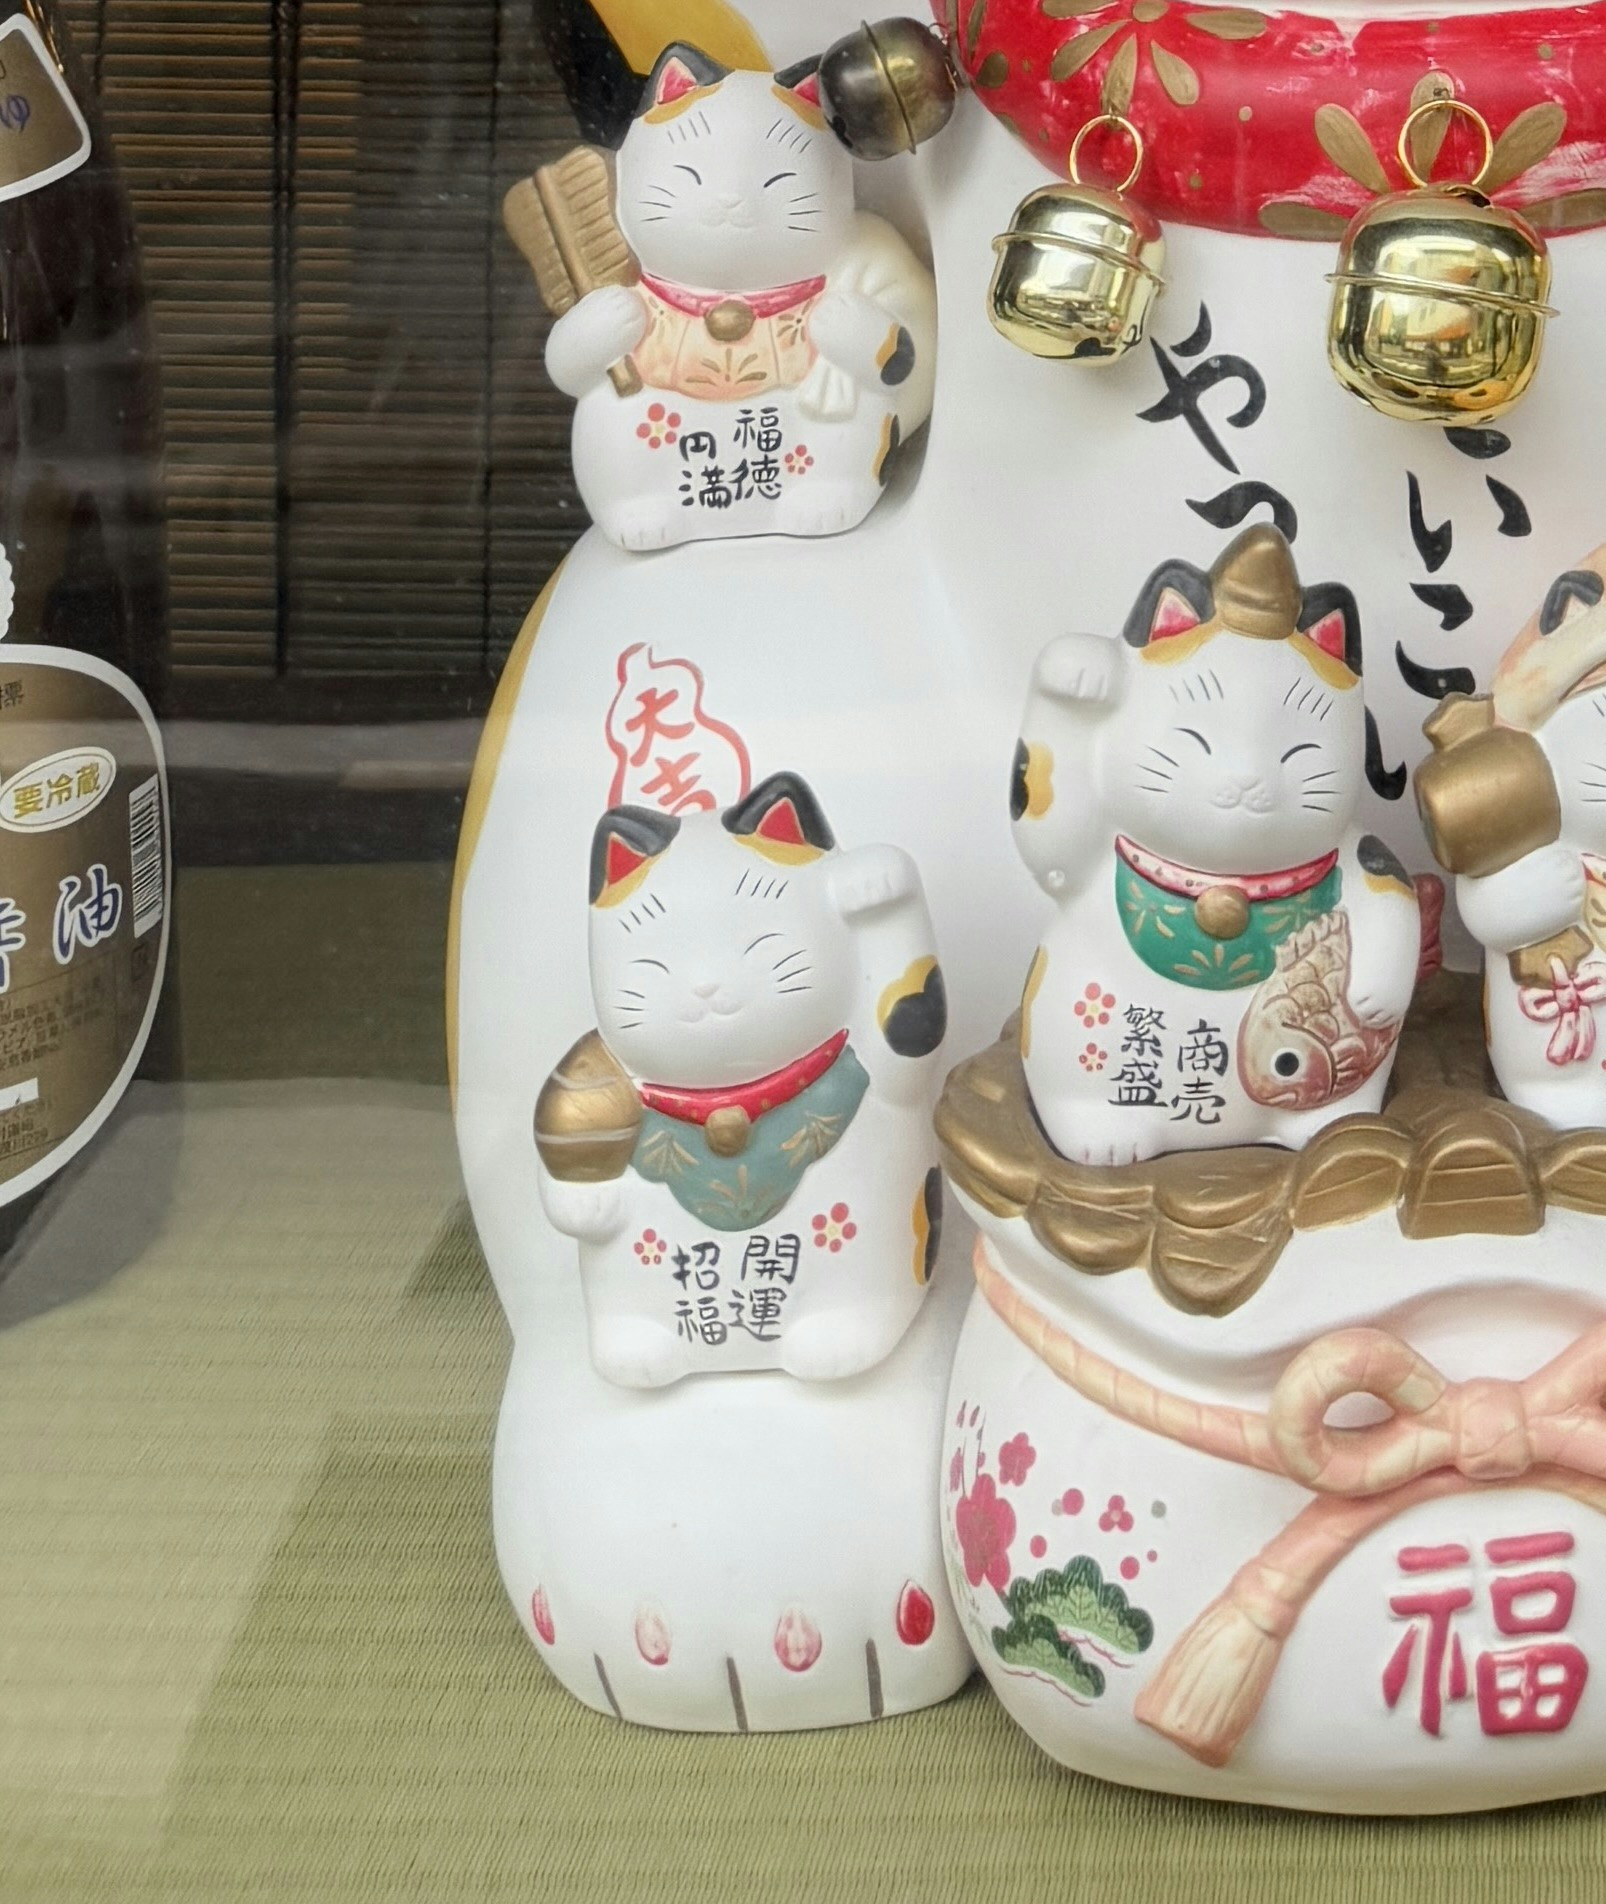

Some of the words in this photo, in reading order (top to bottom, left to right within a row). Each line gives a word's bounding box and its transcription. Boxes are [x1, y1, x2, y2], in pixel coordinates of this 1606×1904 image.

[679, 431, 732, 509] 円満
[728, 407, 783, 500] 福徳
[625, 687, 717, 816] 大吉
[1108, 1003, 1168, 1107] 繁盛
[1169, 1018, 1229, 1125] 商売
[671, 1241, 728, 1346] 招福
[727, 1233, 801, 1342] 開運
[1380, 1530, 1591, 1739] 福
